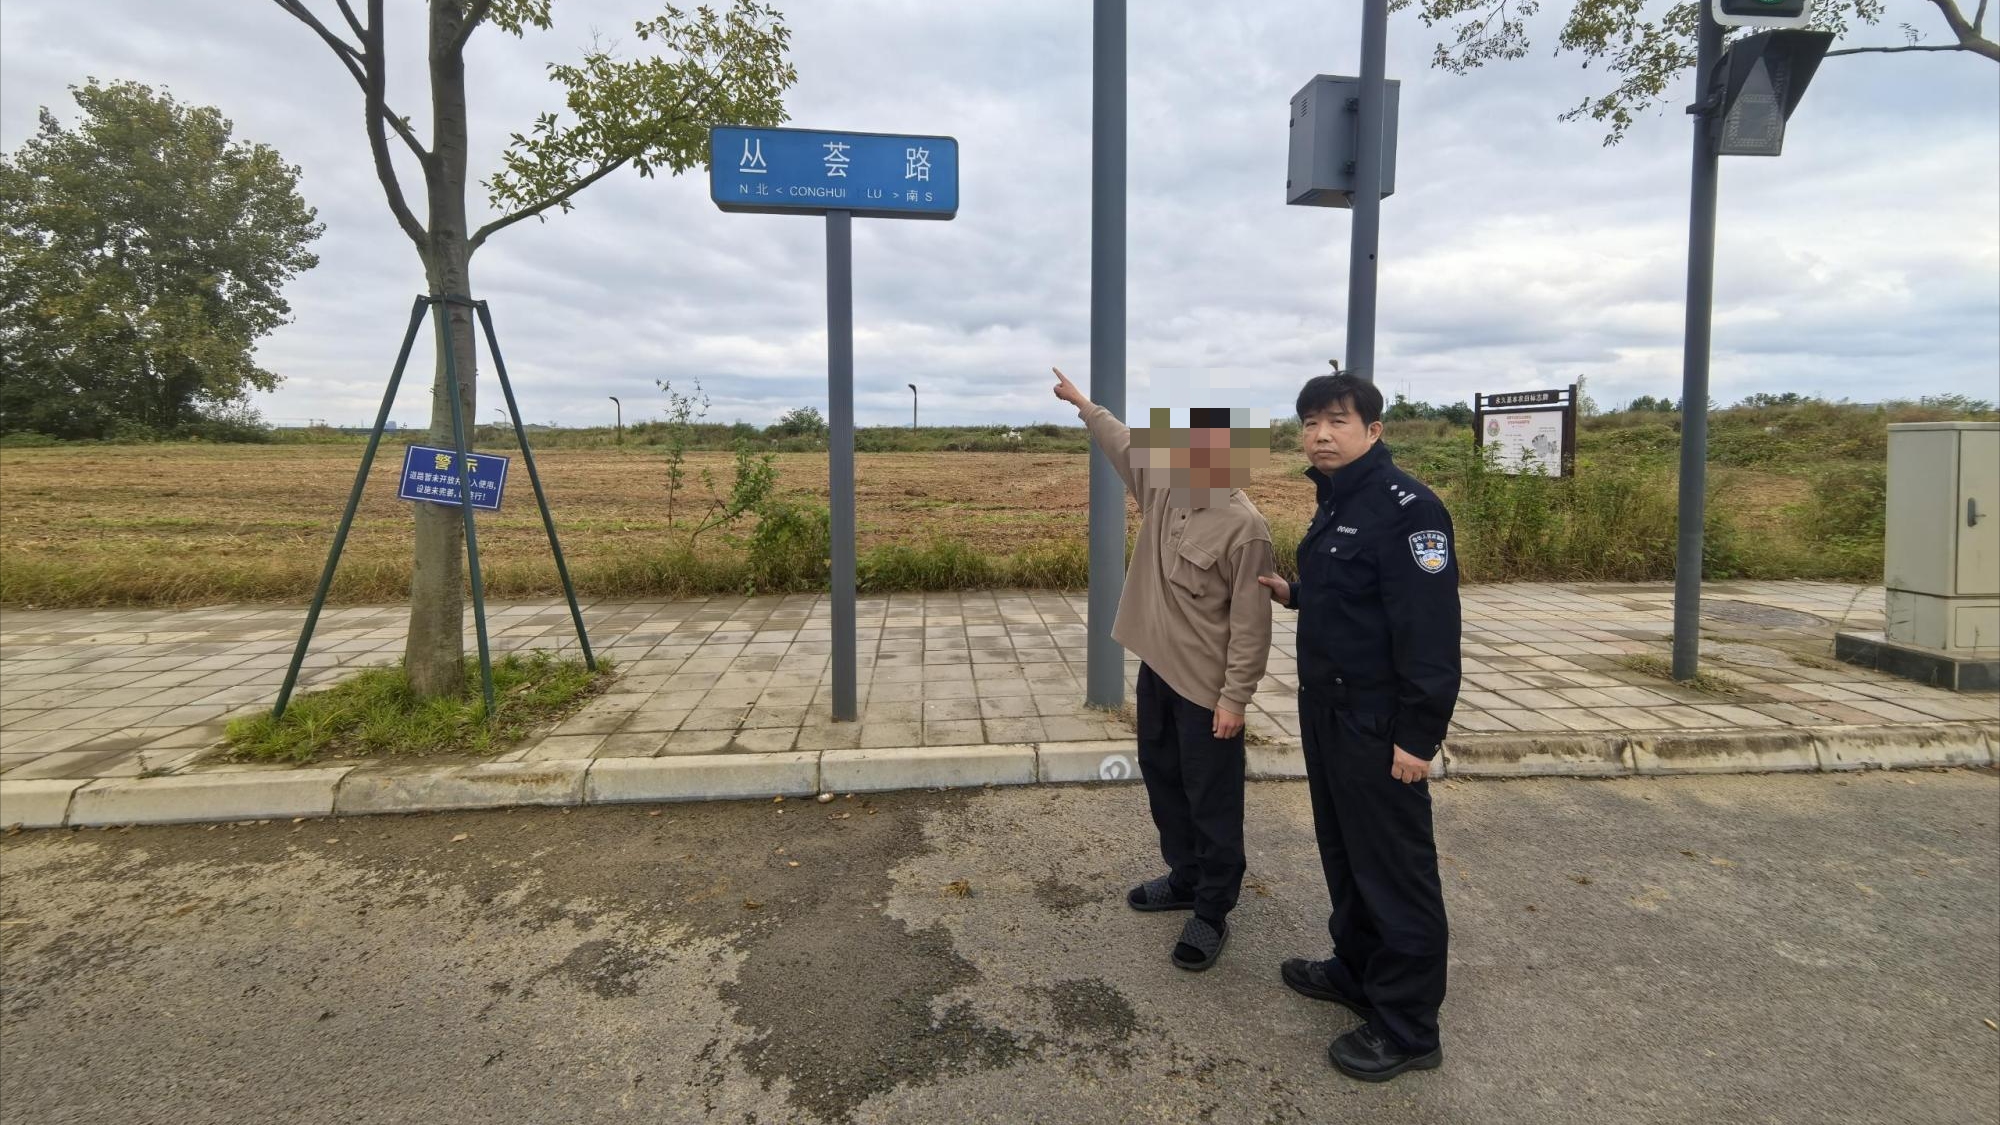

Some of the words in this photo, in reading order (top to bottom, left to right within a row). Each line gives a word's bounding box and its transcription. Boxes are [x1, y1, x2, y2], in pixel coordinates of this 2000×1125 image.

[739, 138, 932, 182] 丛荟路
[739, 184, 748, 195] N
[756, 183, 769, 196] 北
[789, 186, 846, 198] CONGHUI
[867, 187, 882, 199] LU
[906, 189, 918, 202] 南
[925, 192, 933, 202] S
